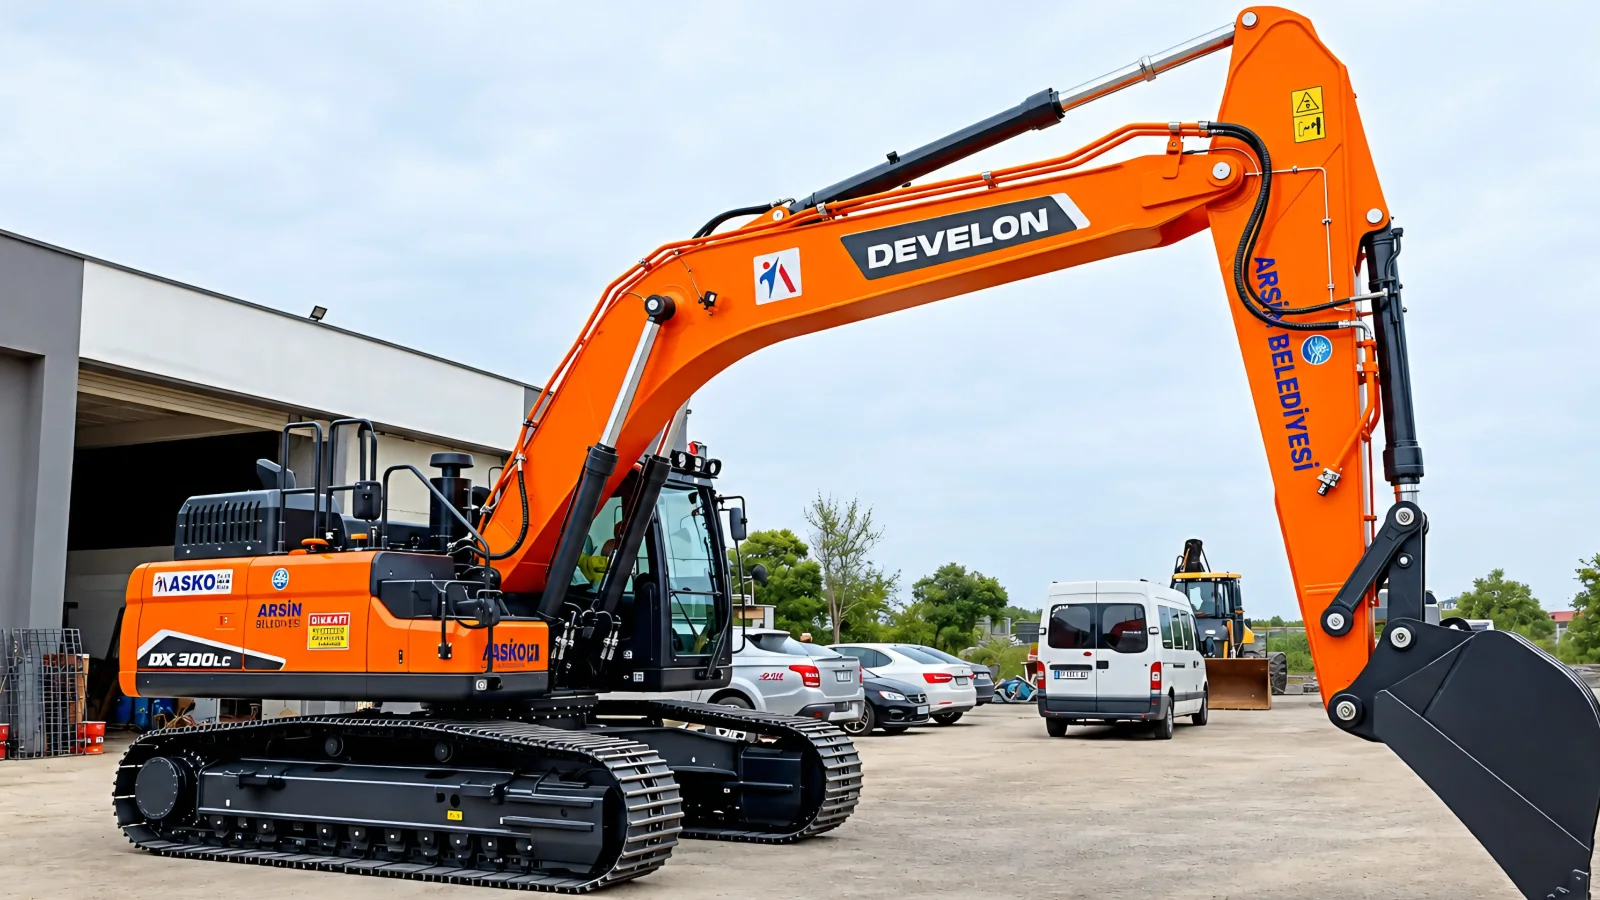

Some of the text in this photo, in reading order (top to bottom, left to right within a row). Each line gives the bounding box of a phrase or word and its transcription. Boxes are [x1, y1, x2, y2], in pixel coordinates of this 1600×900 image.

[867, 207, 1049, 270] DEVELON
[1268, 333, 1320, 471] BELEDİYESİ
[168, 574, 216, 592] ASKO
[257, 599, 303, 617] ARSİN
[147, 653, 232, 667] DX 300LC
